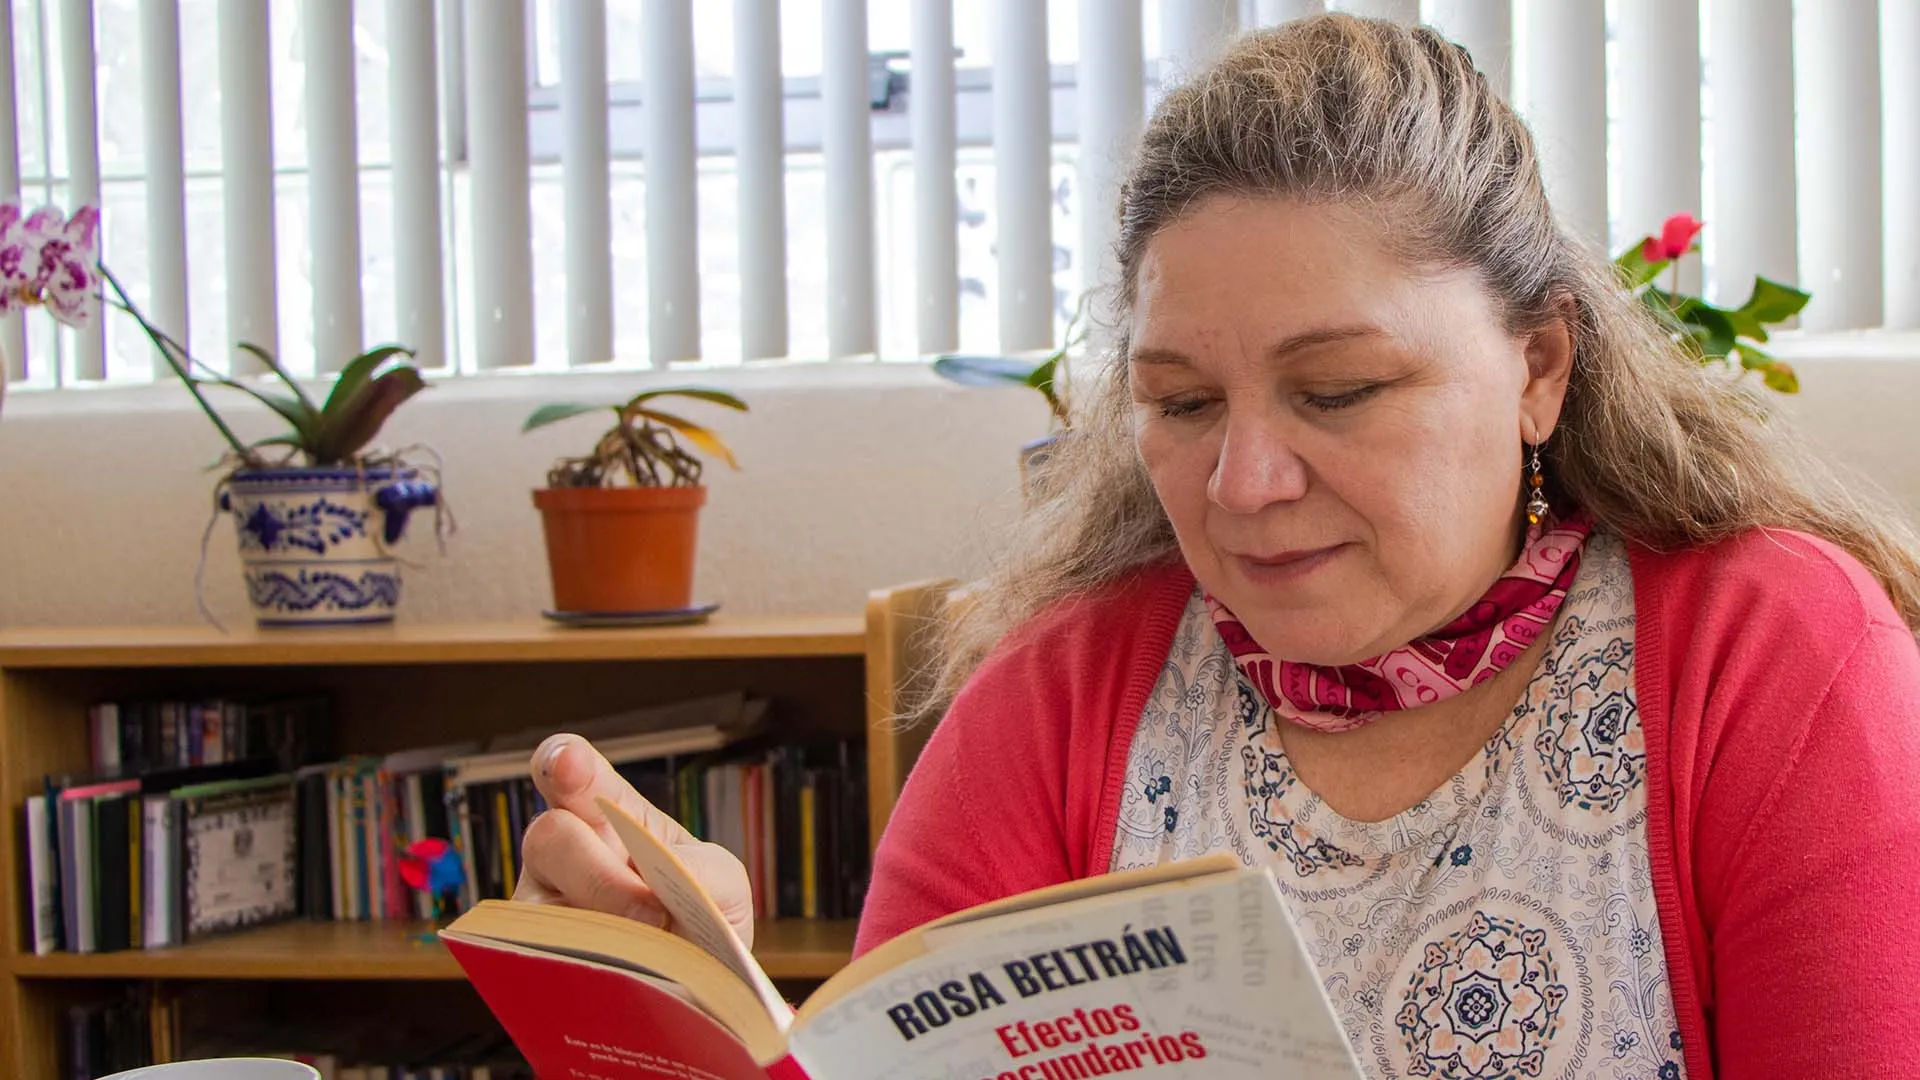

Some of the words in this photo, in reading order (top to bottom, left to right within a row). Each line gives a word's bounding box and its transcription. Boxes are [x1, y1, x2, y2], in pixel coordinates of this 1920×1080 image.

[887, 971, 1007, 1042] ROSA
[1003, 924, 1187, 999] BELTRÁN
[980, 1031, 1208, 1080] cundarios
[994, 1003, 1141, 1058] Efectos
